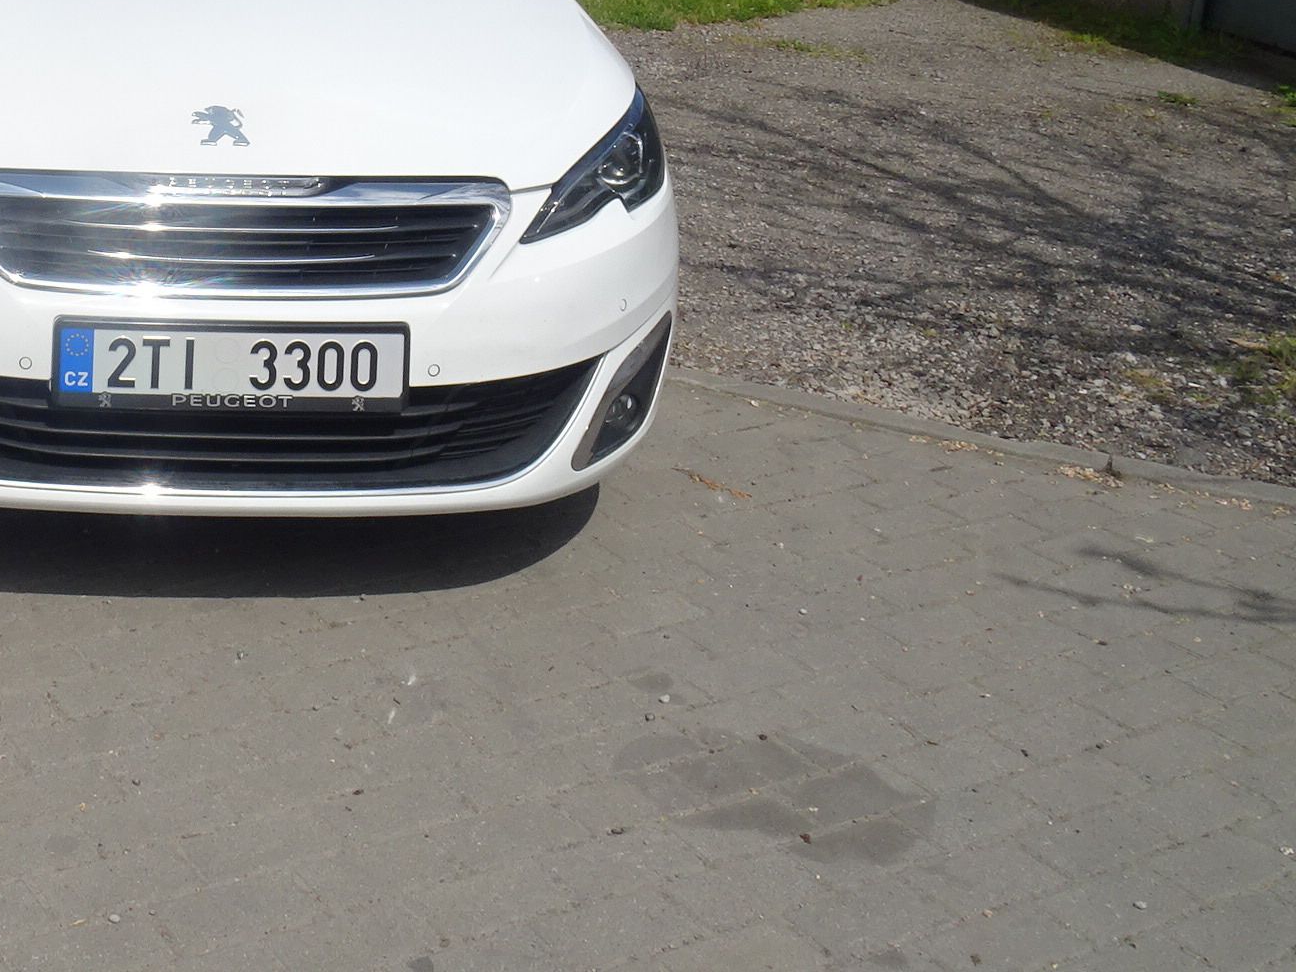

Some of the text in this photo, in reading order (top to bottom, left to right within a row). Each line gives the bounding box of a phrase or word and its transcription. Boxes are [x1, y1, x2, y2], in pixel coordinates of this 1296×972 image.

[248, 340, 380, 392] 3300
[64, 371, 89, 388] CZ
[171, 393, 294, 409] PEUGEOT
